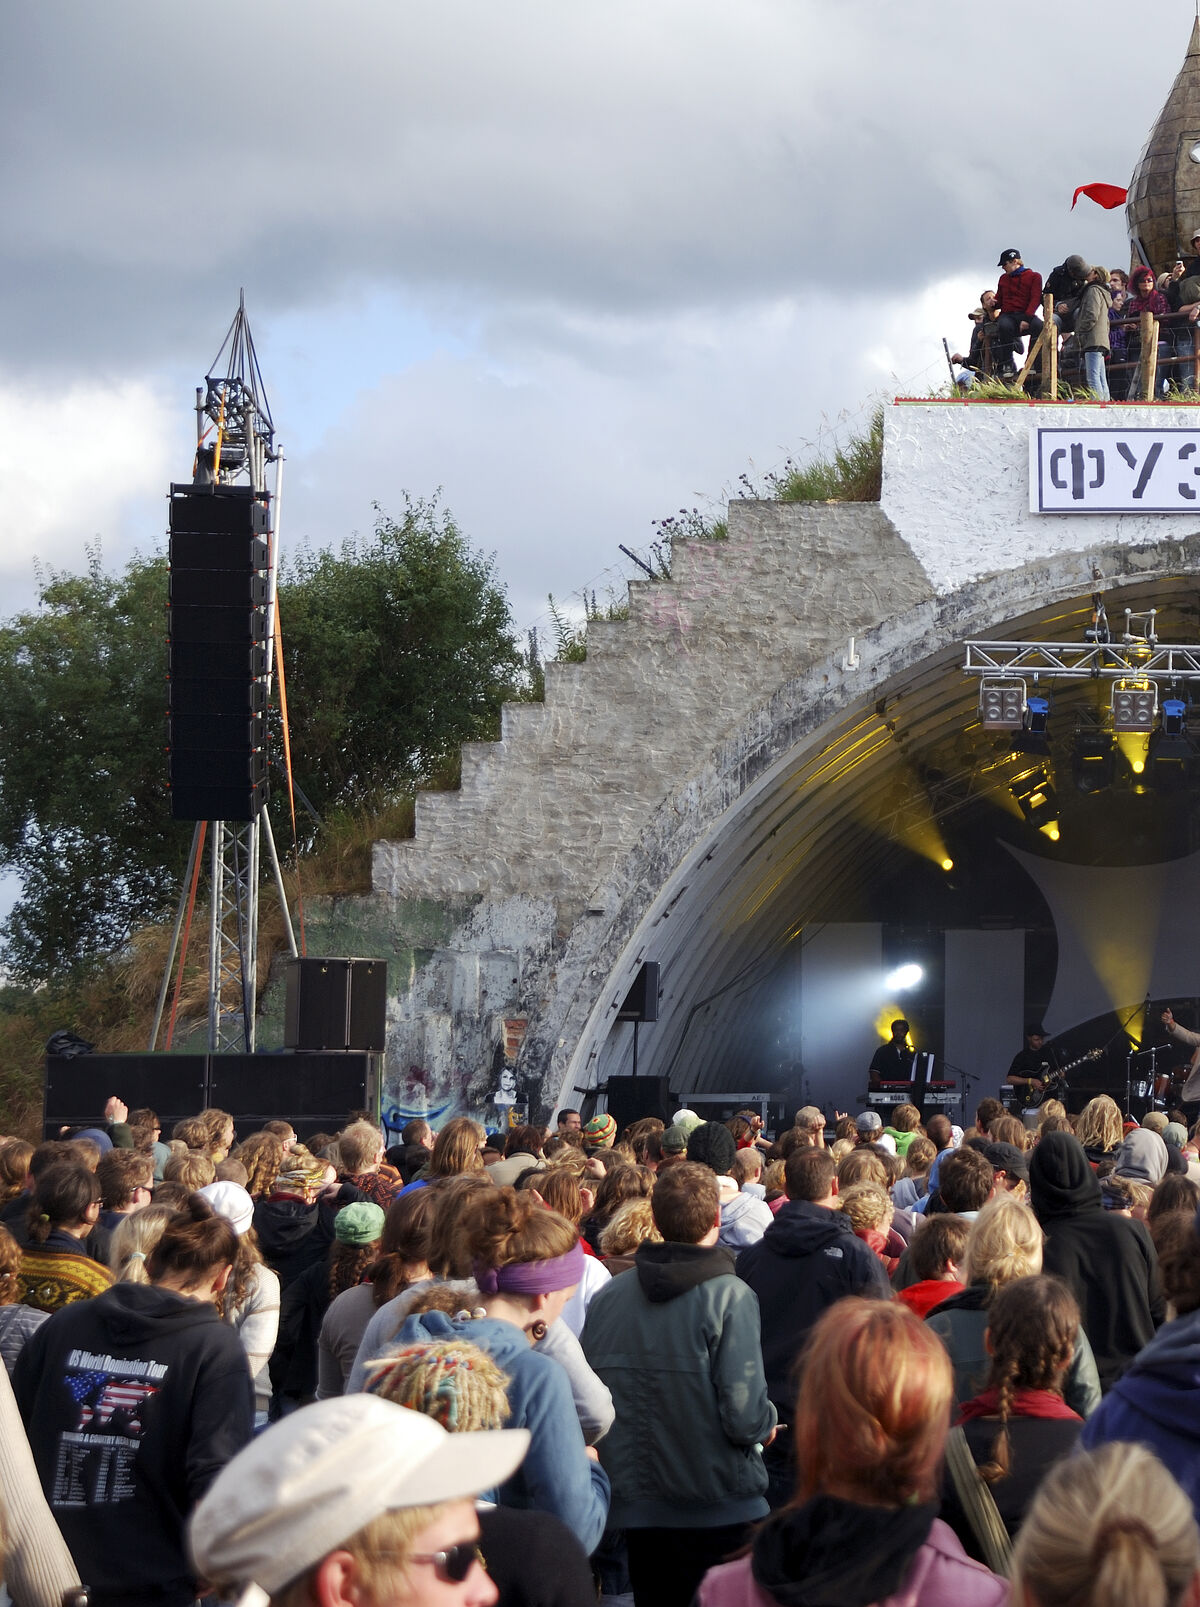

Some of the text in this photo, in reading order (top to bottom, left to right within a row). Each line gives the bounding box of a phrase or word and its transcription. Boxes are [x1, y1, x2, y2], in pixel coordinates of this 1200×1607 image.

[69, 1349, 169, 1379] US World Domination Tour
